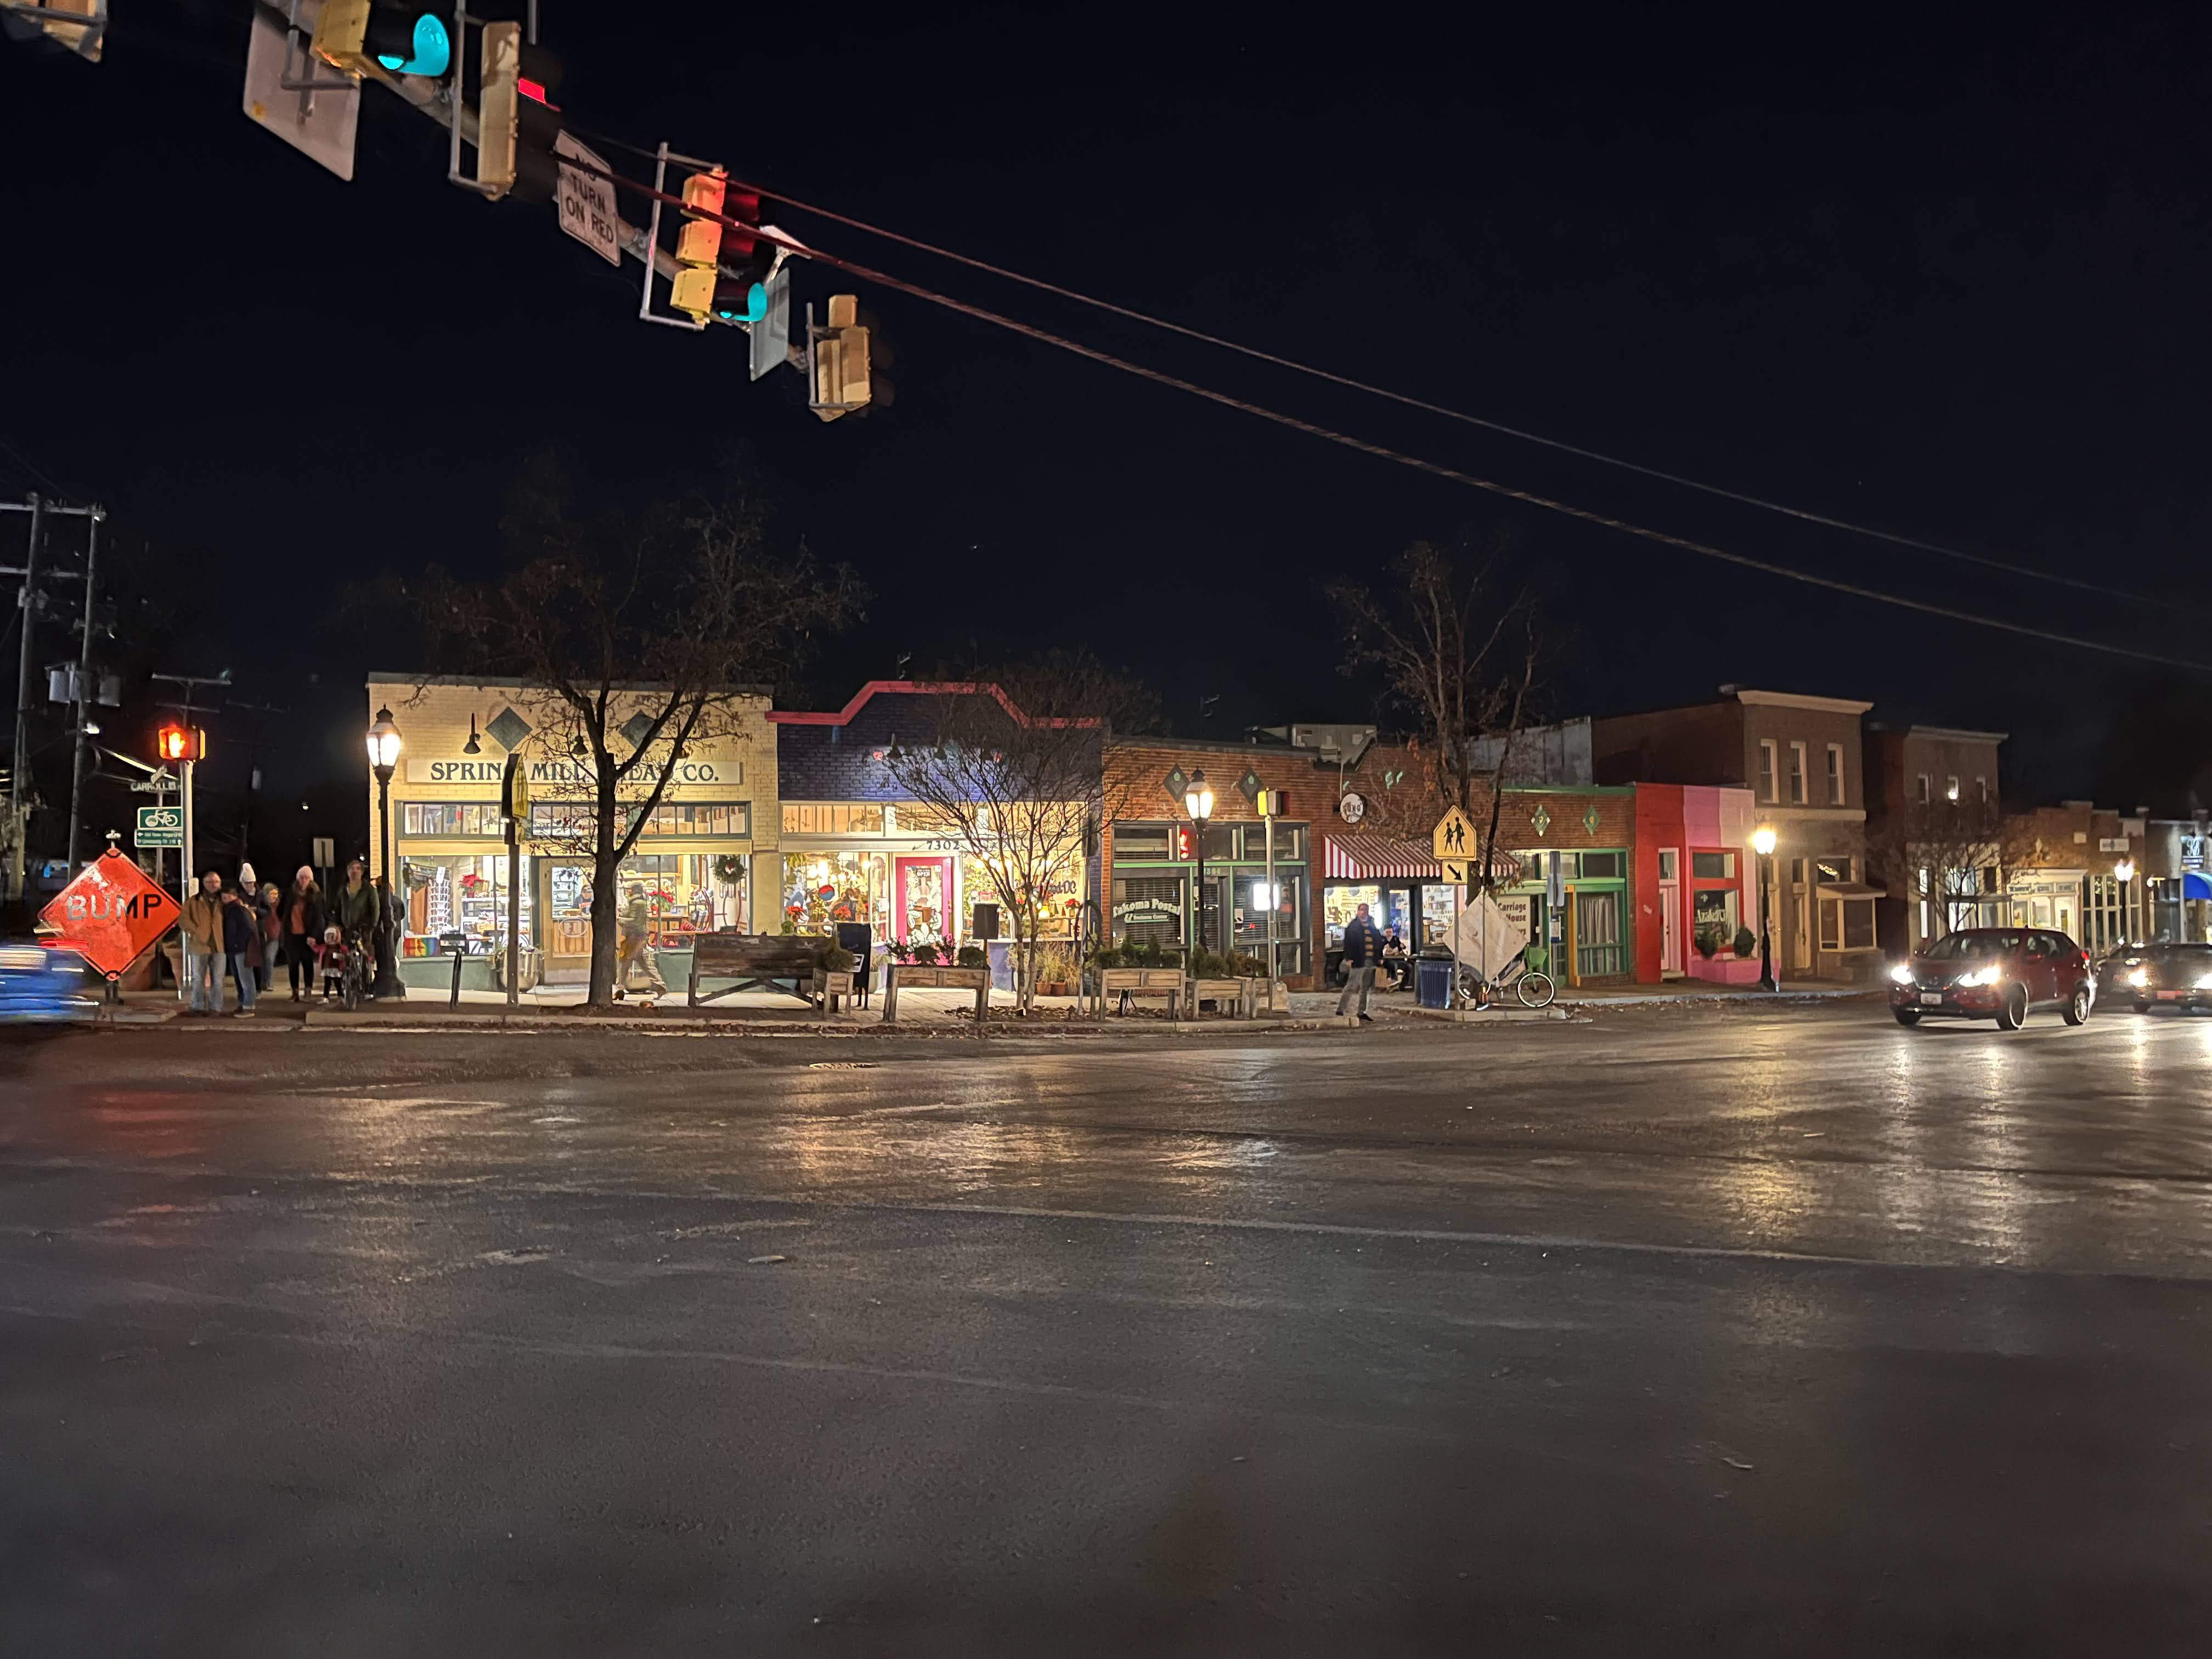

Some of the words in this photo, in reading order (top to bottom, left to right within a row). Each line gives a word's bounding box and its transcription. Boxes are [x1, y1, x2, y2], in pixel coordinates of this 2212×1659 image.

[571, 172, 606, 215] TURN
[566, 196, 585, 224] ON
[591, 212, 614, 243] RED
[430, 762, 503, 780] SPRIN
[530, 763, 586, 780] MILL
[683, 764, 719, 781] CO.
[927, 840, 960, 850] 7302
[67, 894, 162, 921] BUMP
[1498, 901, 1526, 913] Carriage
